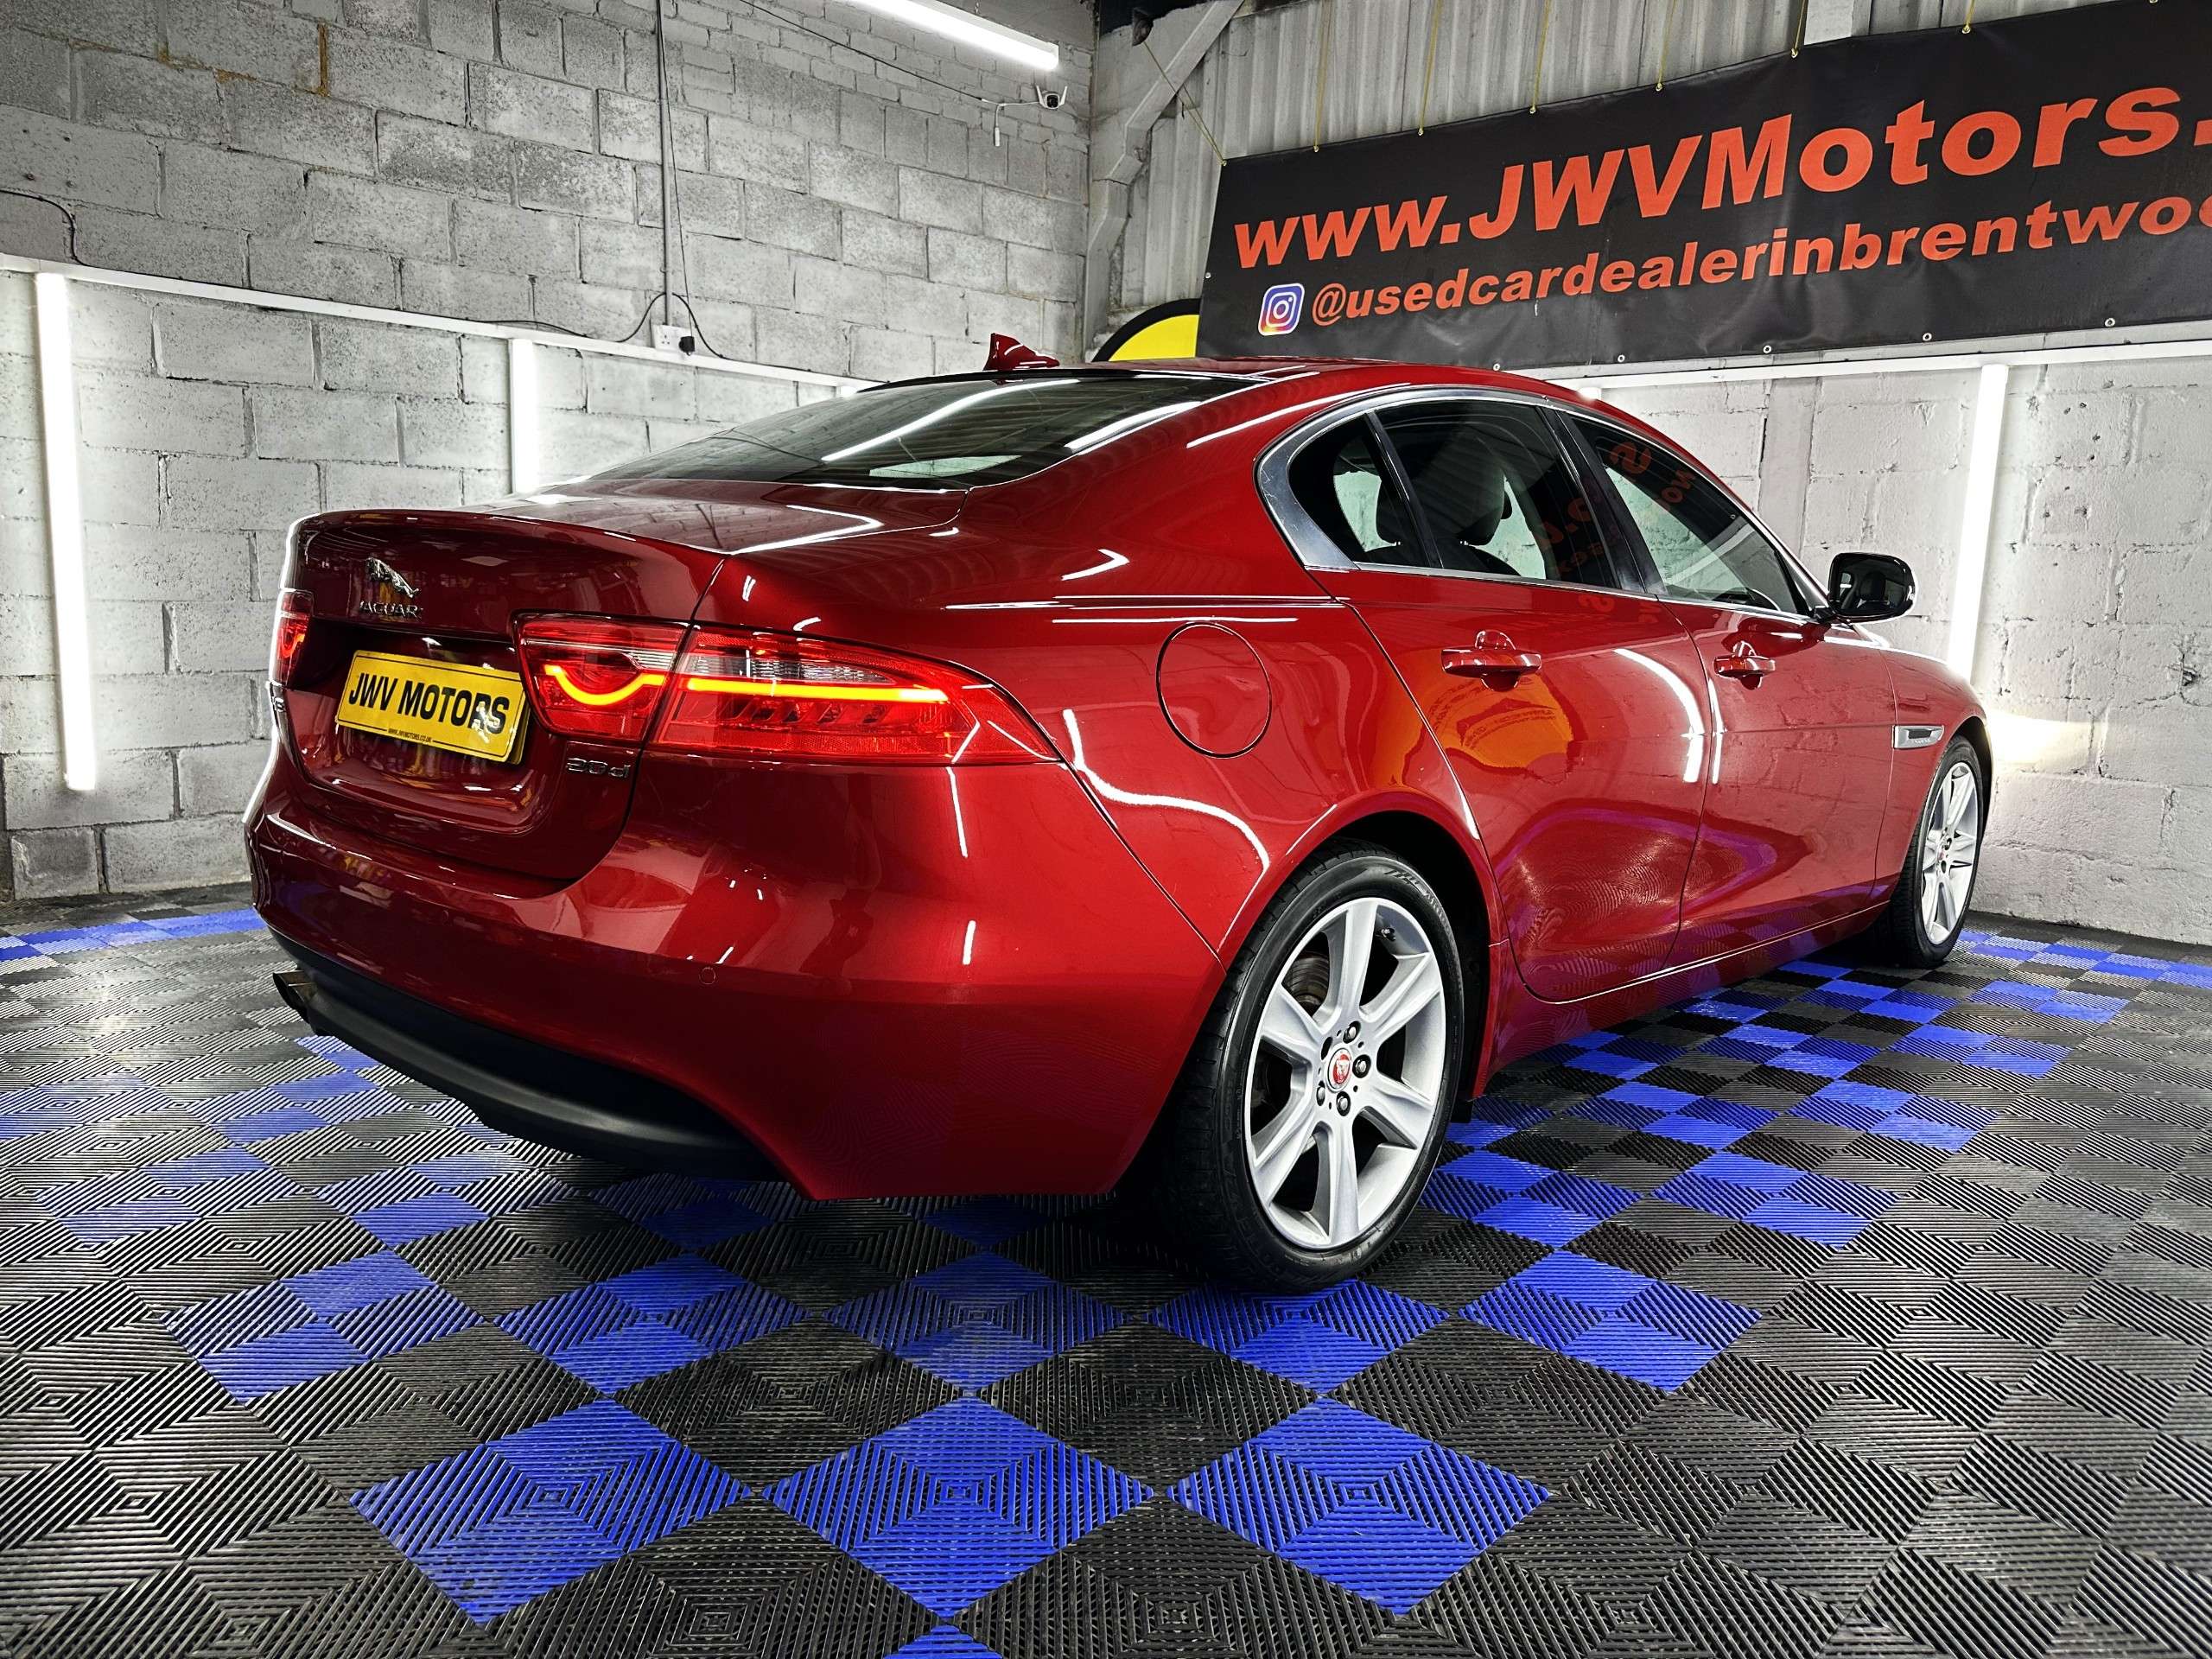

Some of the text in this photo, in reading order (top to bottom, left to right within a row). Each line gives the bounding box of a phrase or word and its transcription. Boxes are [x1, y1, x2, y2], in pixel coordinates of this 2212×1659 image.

[1312, 194, 2212, 327] @usedcardealerinbrentwo
[359, 601, 419, 618] JAGUAR
[348, 672, 510, 734] JWV MOTORS
